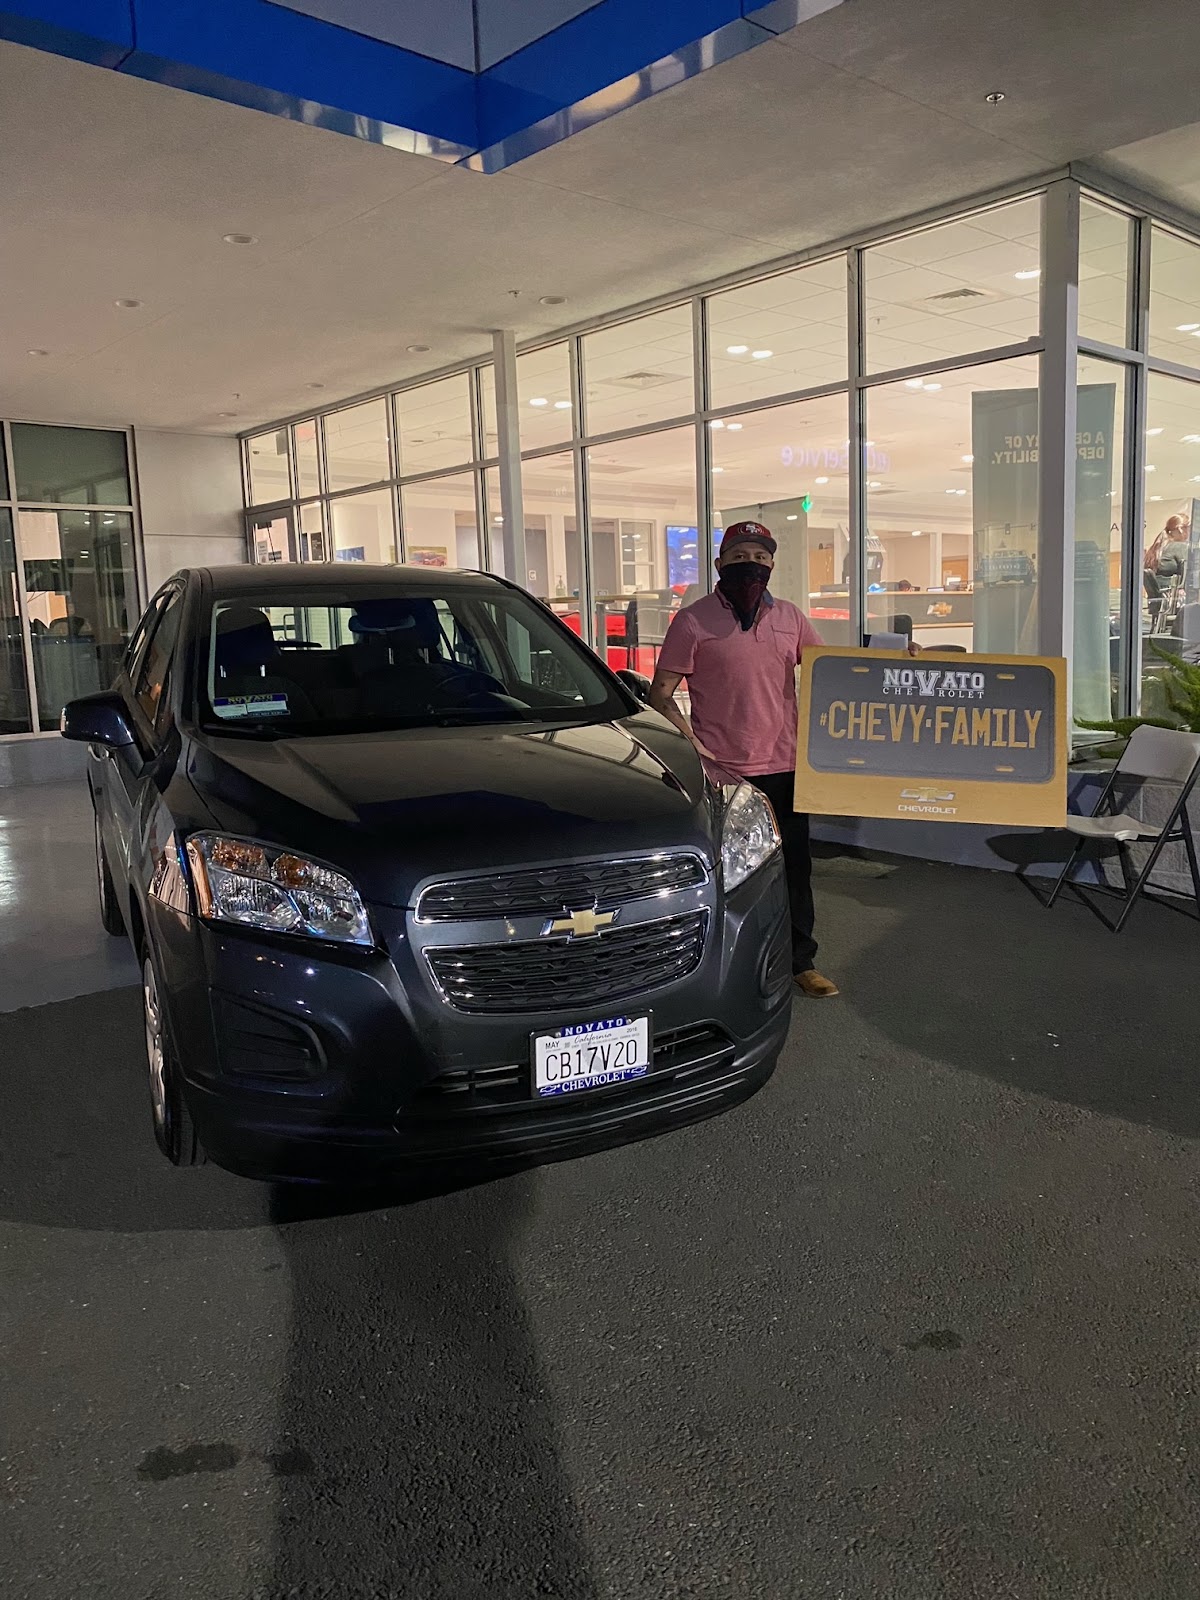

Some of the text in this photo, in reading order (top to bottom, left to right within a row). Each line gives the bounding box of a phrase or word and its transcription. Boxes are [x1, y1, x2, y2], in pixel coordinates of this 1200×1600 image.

[882, 668, 985, 697] NOVATO
[897, 804, 958, 815] CHEVROLET
[565, 1018, 624, 1037] NOVATO
[545, 1040, 560, 1050] MAY
[546, 1039, 637, 1082] CB17V20
[561, 1070, 627, 1092] CHEVROLET
